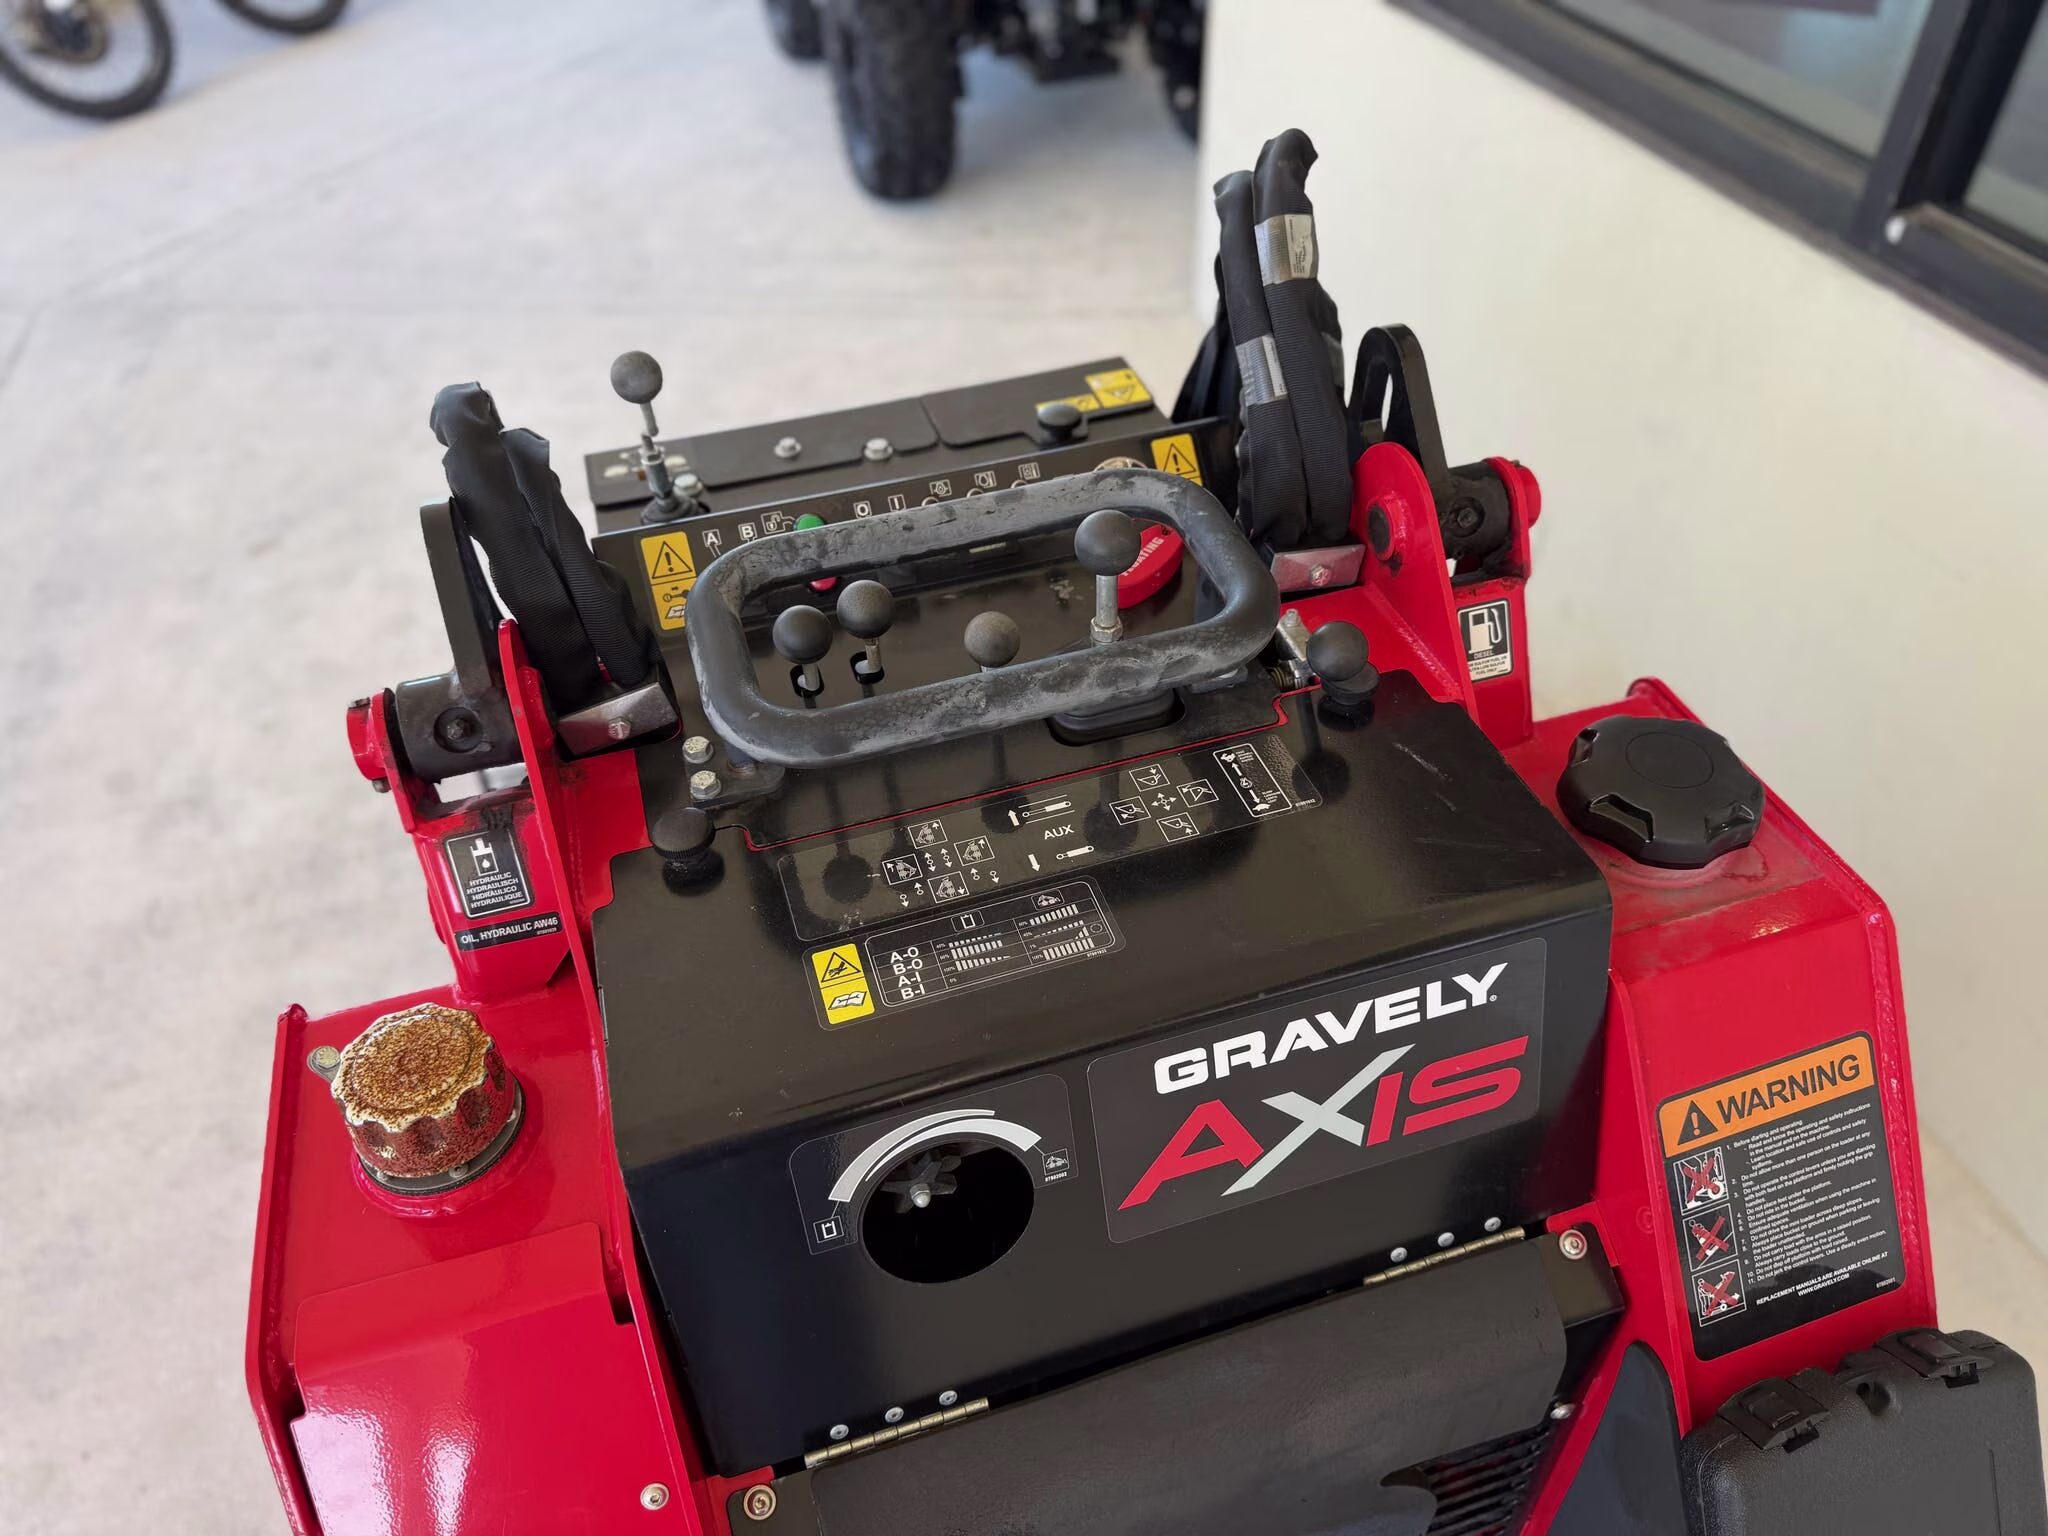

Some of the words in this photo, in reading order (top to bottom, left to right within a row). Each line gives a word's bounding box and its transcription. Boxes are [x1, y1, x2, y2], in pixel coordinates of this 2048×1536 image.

[707, 532, 719, 545] A
[743, 526, 755, 539] B
[1043, 823, 1074, 841] AUX
[467, 878, 518, 894] HYDRAULISCH
[470, 872, 512, 886] HYDRAULIC
[470, 892, 522, 908] HYDRAULIQUE
[461, 933, 479, 945] OIL,
[480, 922, 532, 941] HYDRAULIC
[533, 917, 558, 930] AW46
[1153, 962, 1508, 1095] GRAVELY
[1716, 1053, 1861, 1125] WARNING
[1118, 1036, 1528, 1210] AXIS
[1756, 1286, 1795, 1304] REPLACEMENT
[1795, 1276, 1821, 1290] MANUALS
[1821, 1271, 1833, 1280] ARE
[1833, 1261, 1861, 1276] AVAILABLE
[1861, 1254, 1880, 1265] ONLINE
[1797, 1272, 1849, 1296] WWW.GRAVELY.COM
